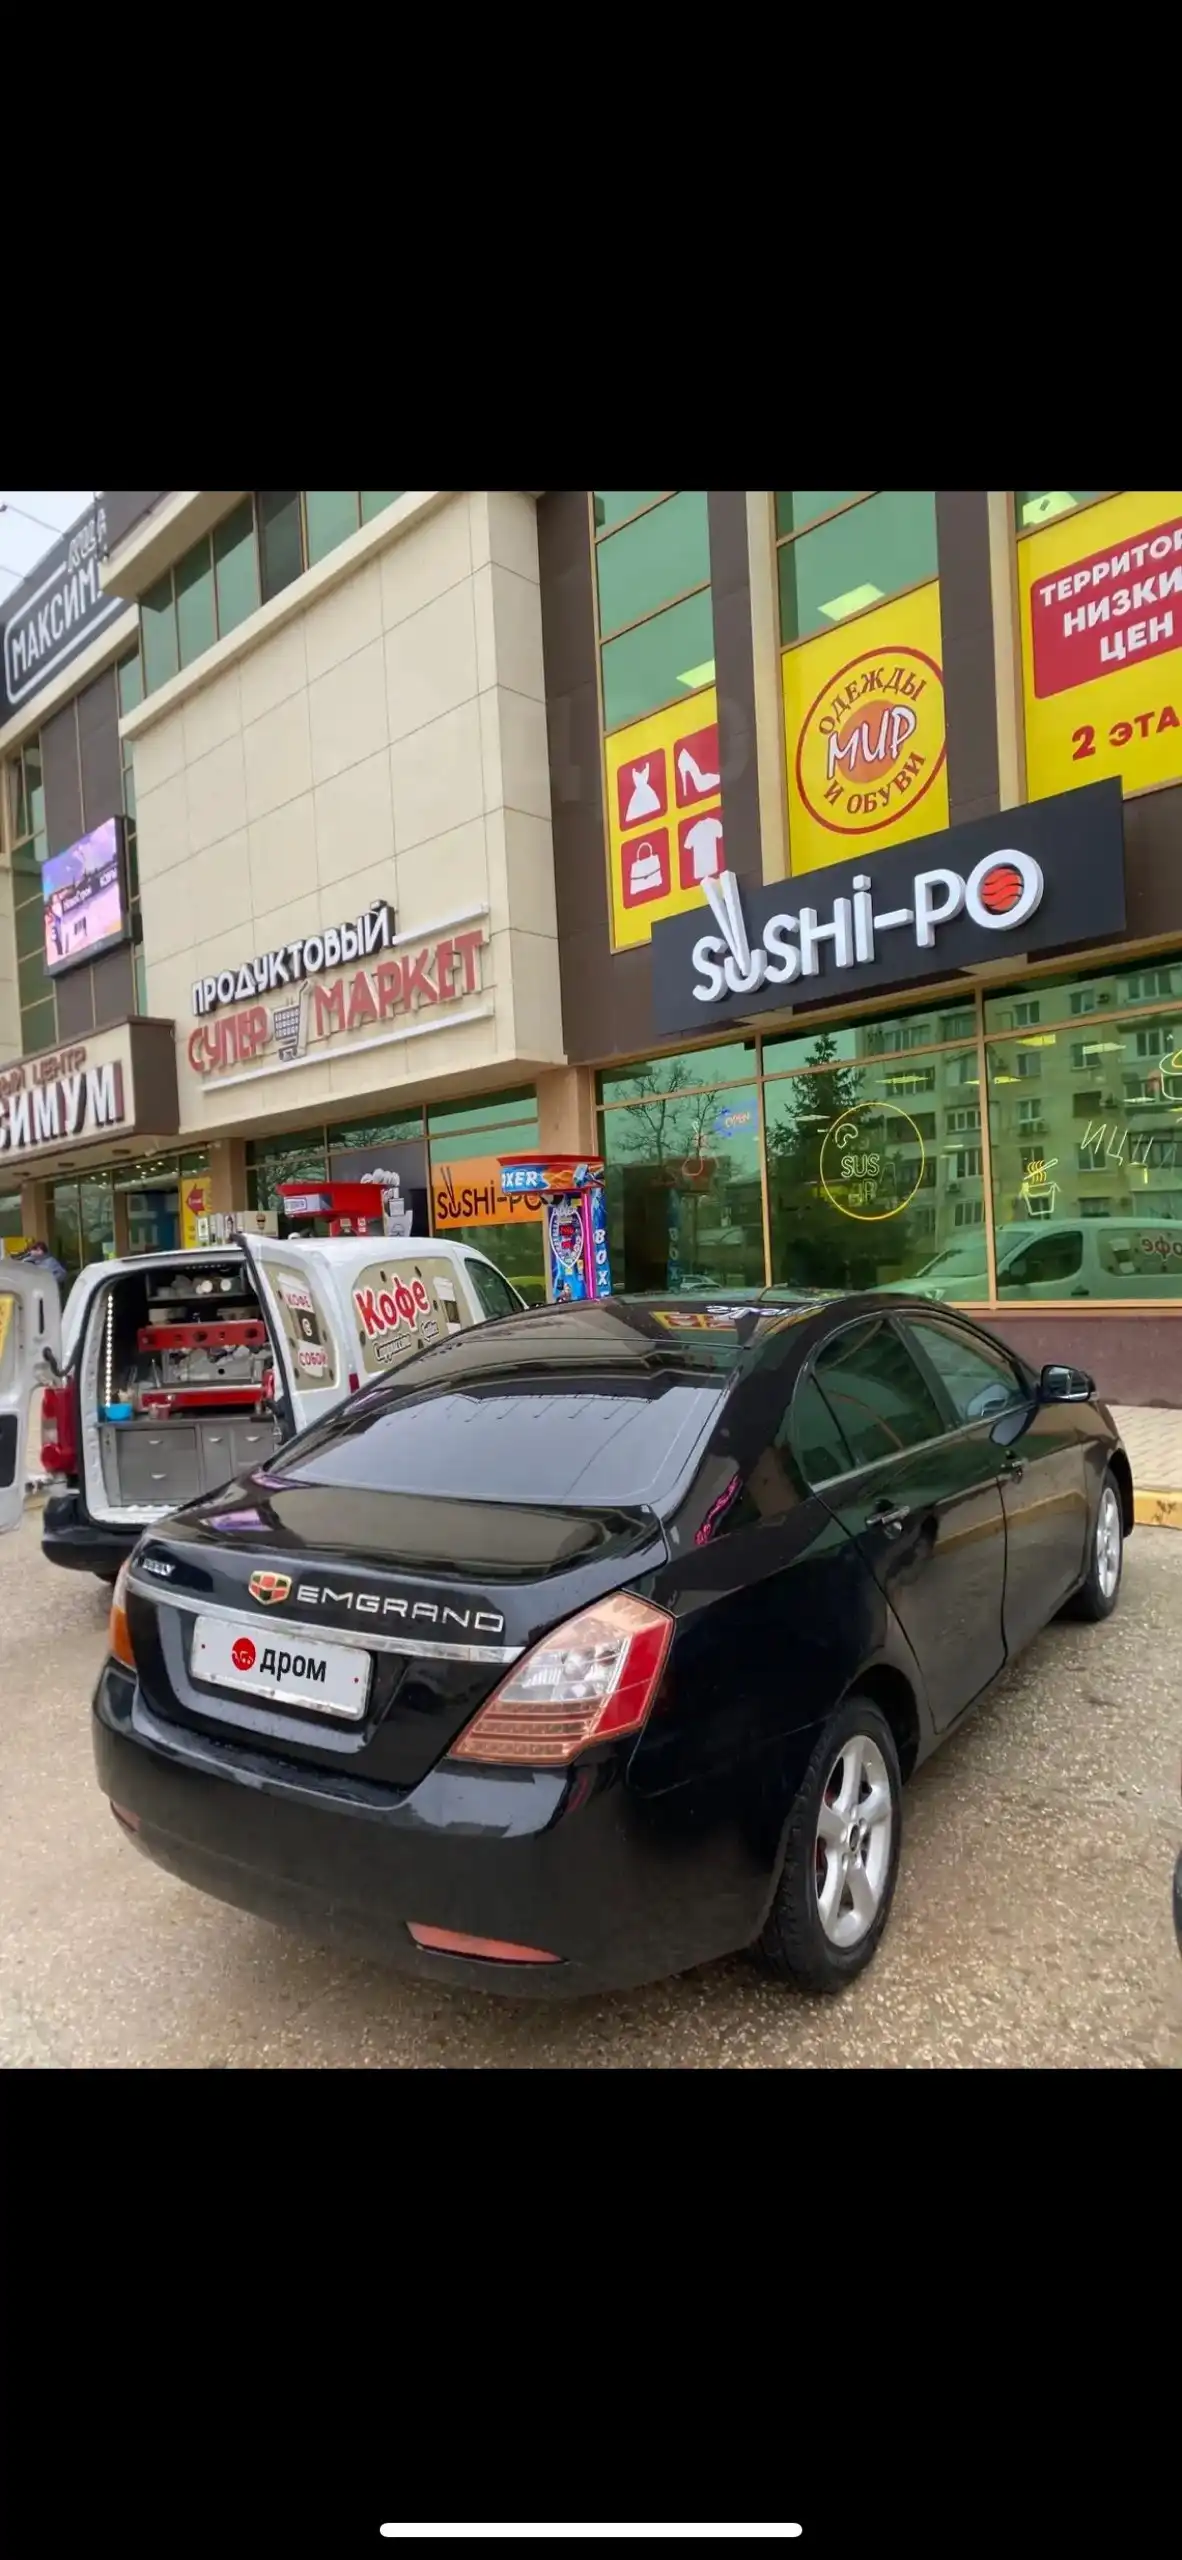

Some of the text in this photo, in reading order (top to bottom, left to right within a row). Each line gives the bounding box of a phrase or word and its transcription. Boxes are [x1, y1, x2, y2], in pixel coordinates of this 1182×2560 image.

[12, 556, 104, 682] МАКСИМ
[1099, 610, 1174, 664] ЦЕН
[818, 666, 928, 736] ОДЕЖДЫ
[1071, 704, 1180, 762] 2 ЭТА
[823, 750, 927, 815] И ОБУВИ
[191, 899, 396, 1016] ПРОДУКТОВЫЙ
[187, 927, 487, 1074] СУПЕР МАРКЕТ
[33, 1045, 87, 1085] ЦЕНТР
[285, 1293, 312, 1308] КОФЕ
[355, 1275, 431, 1336] Кофе
[299, 1350, 329, 1367] СОБОЙ
[296, 1584, 505, 1633] EMGRAND
